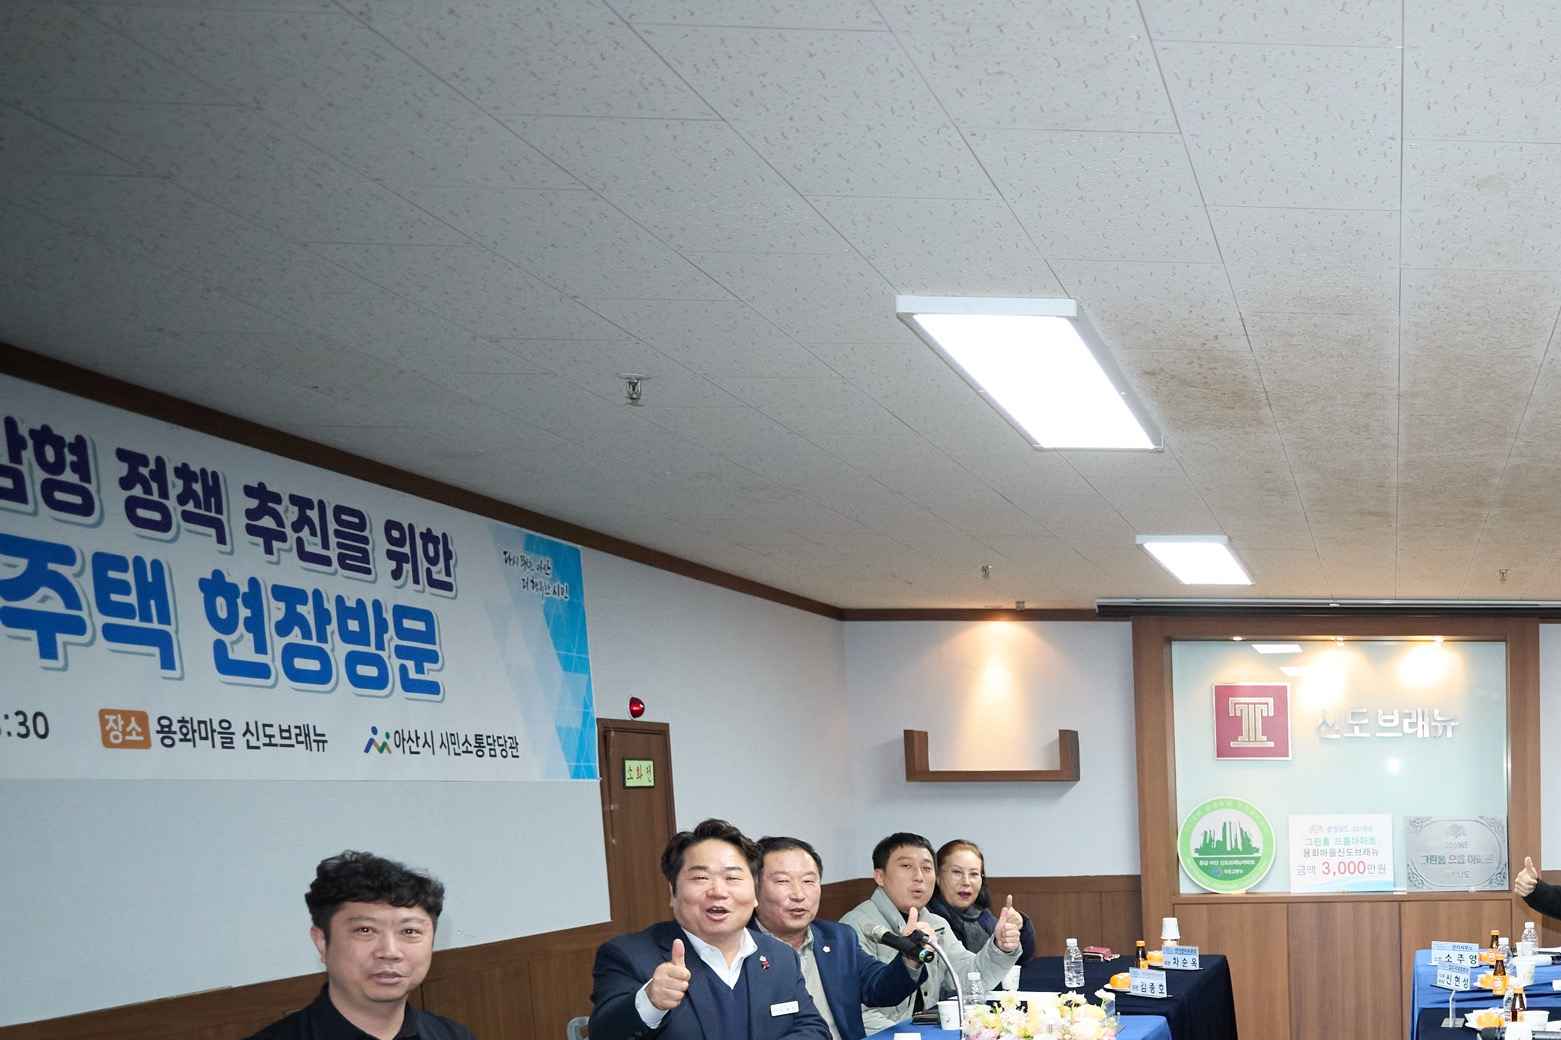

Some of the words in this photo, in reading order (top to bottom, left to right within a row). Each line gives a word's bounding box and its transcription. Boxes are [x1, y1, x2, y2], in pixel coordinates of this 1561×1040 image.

[115, 447, 227, 546] 정책
[243, 482, 373, 568] 추진을
[384, 519, 455, 593] 위한
[0, 532, 177, 671] 주택
[198, 569, 442, 696] 현장방문
[0, 710, 50, 739] :30
[104, 714, 144, 744] 장소
[156, 715, 236, 750] 용화마을
[242, 720, 328, 753] 신도브래뉴
[393, 728, 435, 755] 아산시
[439, 731, 520, 759] 시민소통담당관
